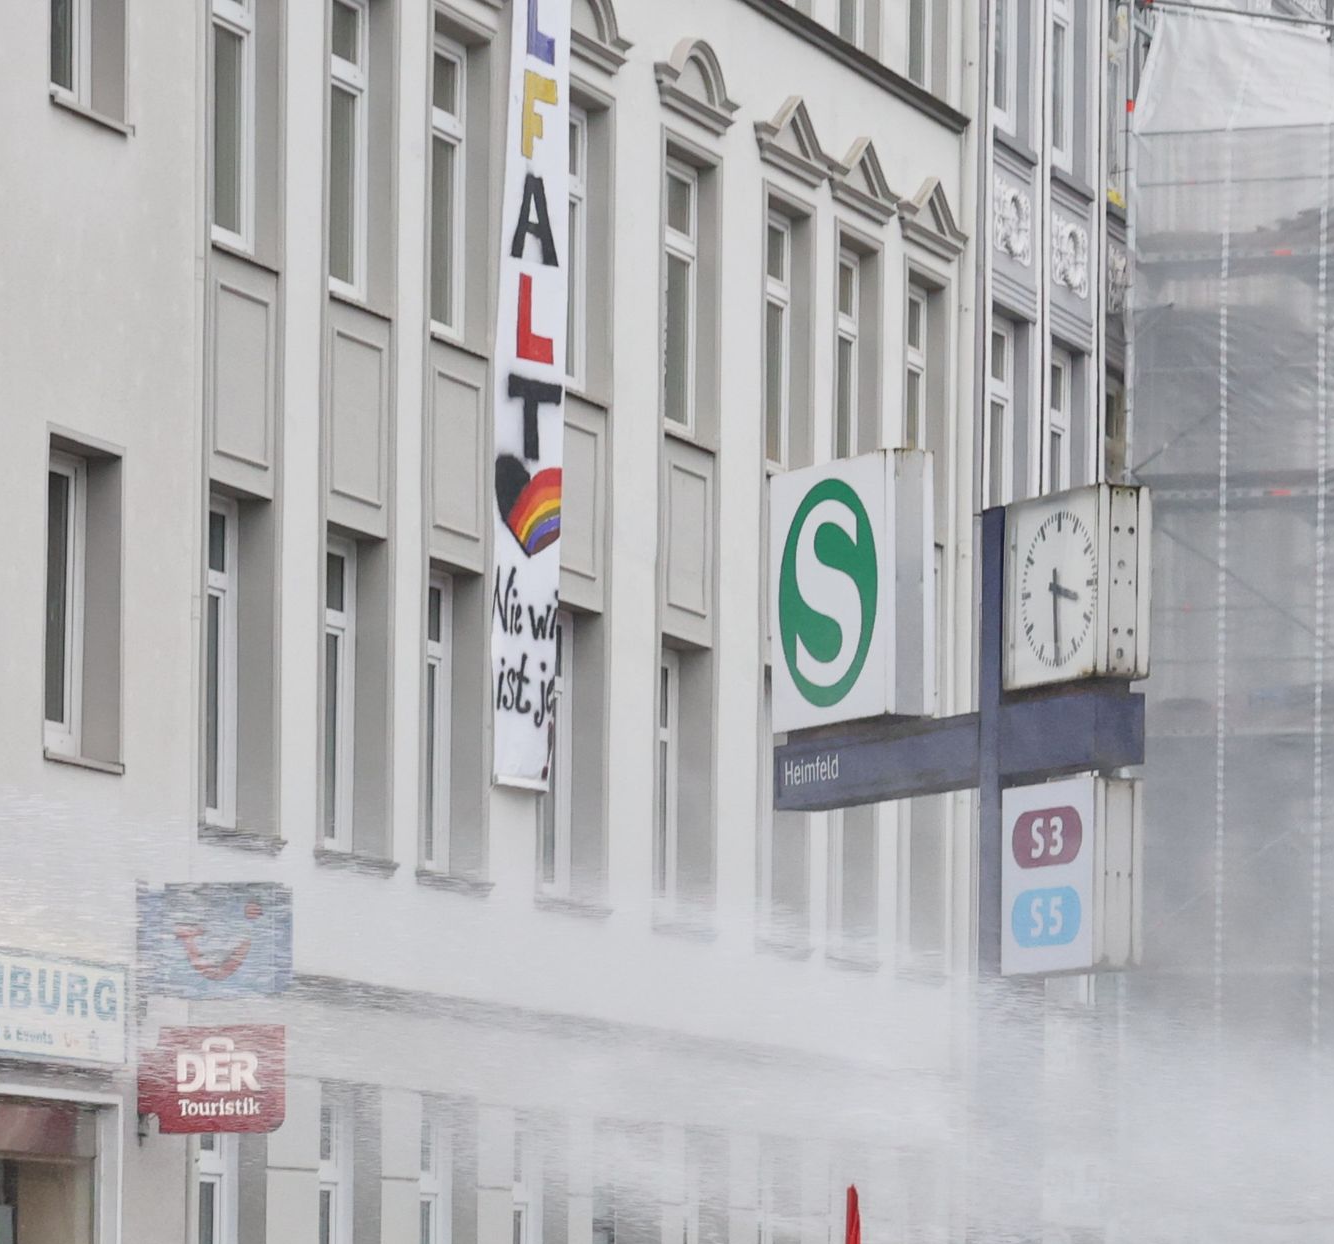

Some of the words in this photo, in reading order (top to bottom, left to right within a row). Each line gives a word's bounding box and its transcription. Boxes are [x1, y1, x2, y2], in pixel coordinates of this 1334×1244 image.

[492, 565, 523, 637] Nie
[795, 498, 864, 688] S
[497, 653, 530, 714] ist
[784, 754, 840, 787] Heimfeld
[176, 1052, 261, 1093] DER
[178, 1098, 261, 1117] Touristik
